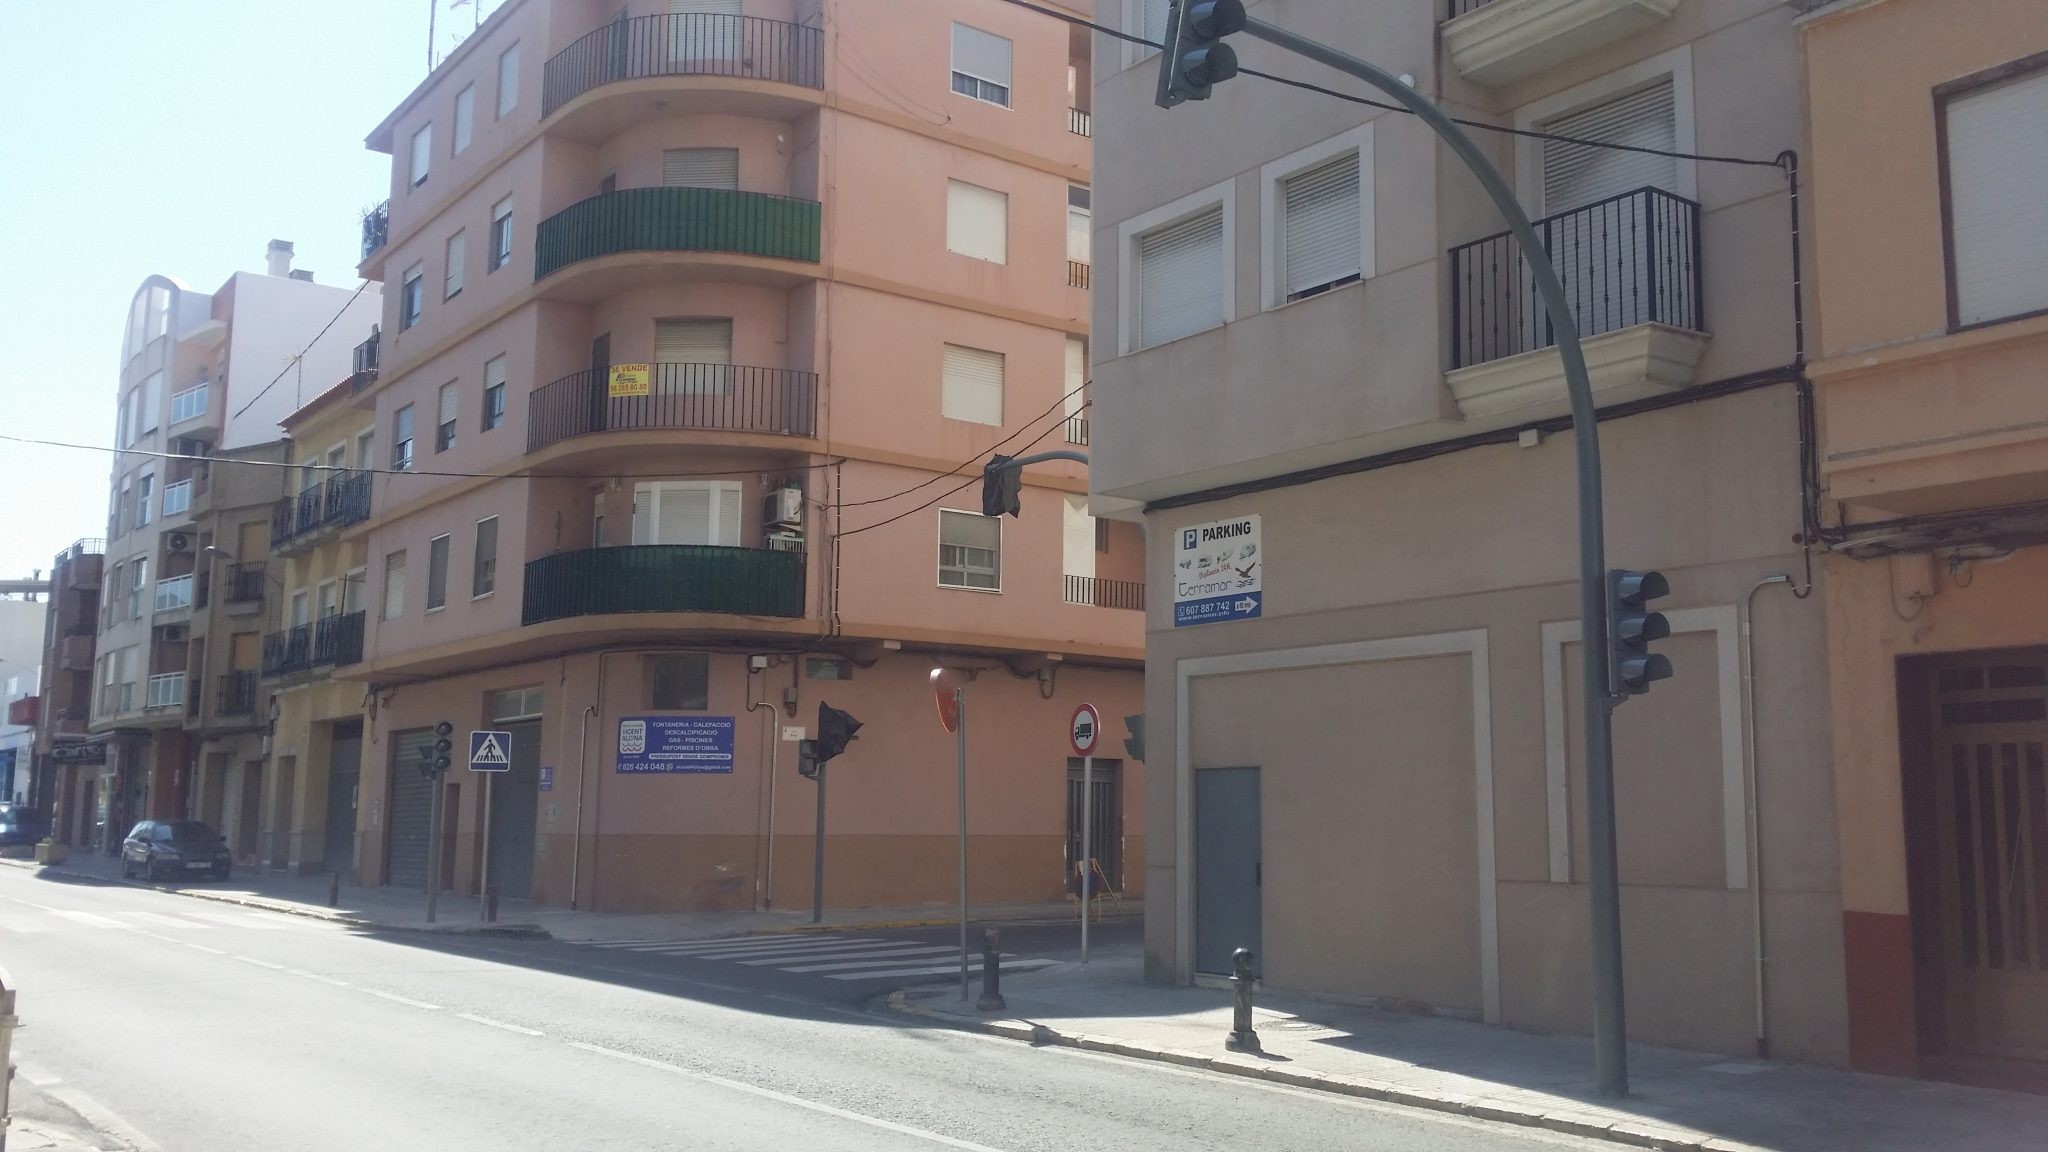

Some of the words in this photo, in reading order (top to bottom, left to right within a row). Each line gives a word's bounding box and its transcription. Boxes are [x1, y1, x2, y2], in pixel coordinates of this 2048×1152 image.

[1203, 521, 1251, 541] PARKING
[1186, 606, 1199, 615] 607
[1200, 604, 1214, 613] 887
[1216, 601, 1230, 611] 742
